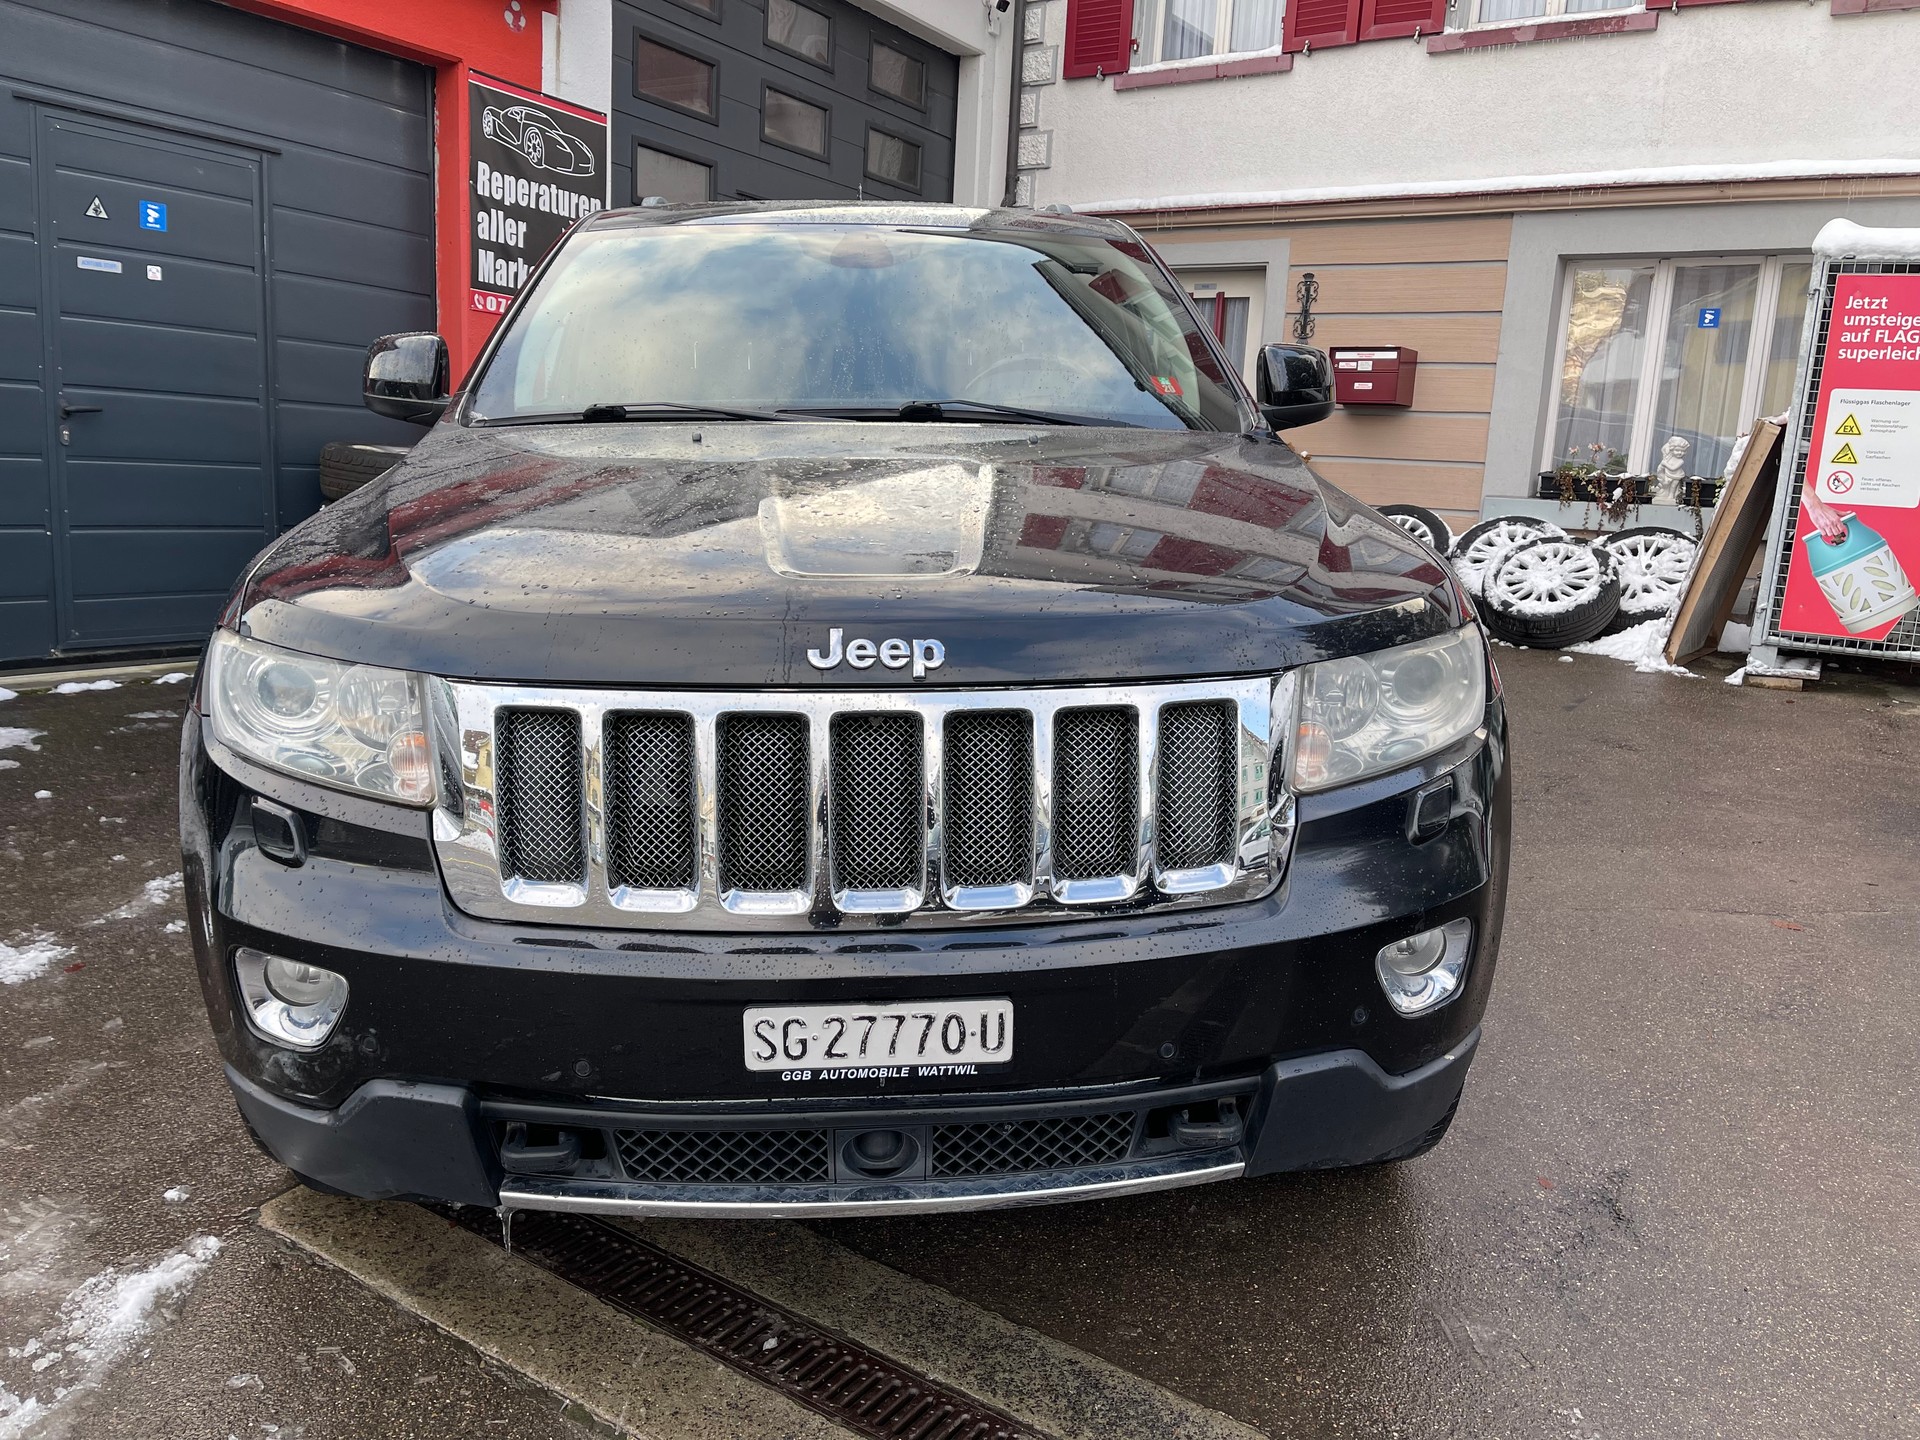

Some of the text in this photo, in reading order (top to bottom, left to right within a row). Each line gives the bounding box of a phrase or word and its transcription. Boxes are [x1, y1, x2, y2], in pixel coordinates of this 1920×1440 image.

[477, 161, 602, 219] Reperaturen
[477, 208, 527, 248] aller
[478, 248, 535, 289] Mark
[486, 296, 512, 315] 07
[1845, 296, 1888, 309] Jetzt
[1844, 312, 1920, 330] umsteige
[1841, 329, 1870, 343] auf
[1843, 425, 1855, 433] EX
[807, 628, 945, 680] Jeep
[781, 1065, 978, 1081] GGB AUTOMOBILE WATTWIL
